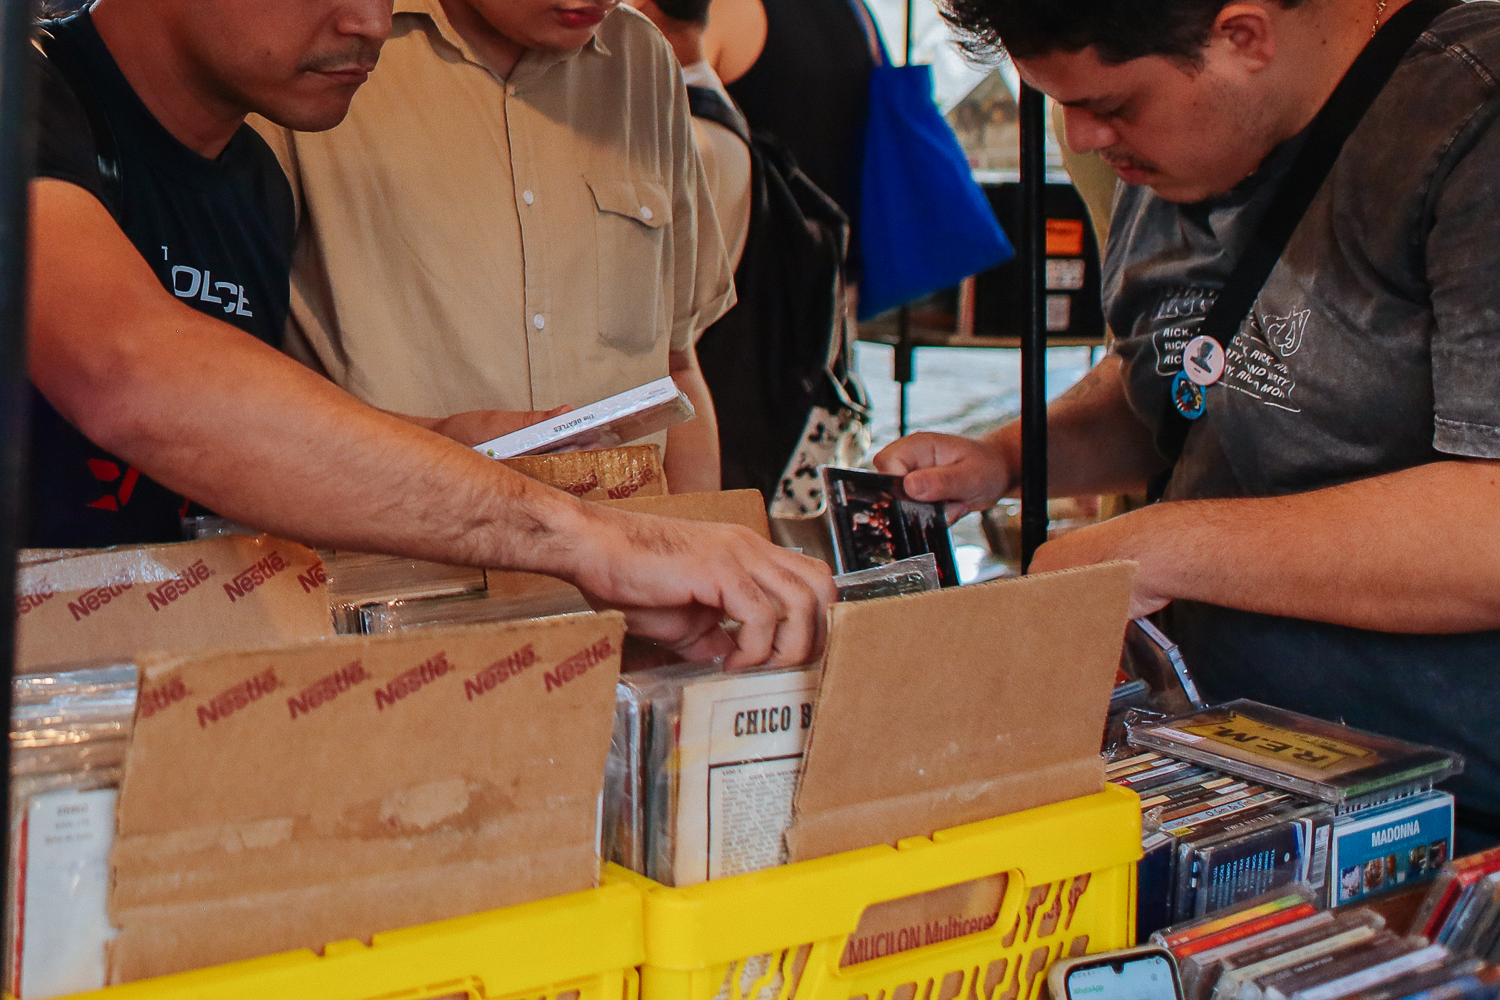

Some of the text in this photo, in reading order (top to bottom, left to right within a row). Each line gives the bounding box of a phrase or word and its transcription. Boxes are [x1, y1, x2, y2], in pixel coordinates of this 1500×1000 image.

[553, 418, 583, 434] BEATLES
[734, 705, 791, 737] CHICO
[1372, 820, 1421, 847] MADONNA
[925, 913, 1000, 944] Multicere
[1073, 983, 1104, 995] WhatsApp
